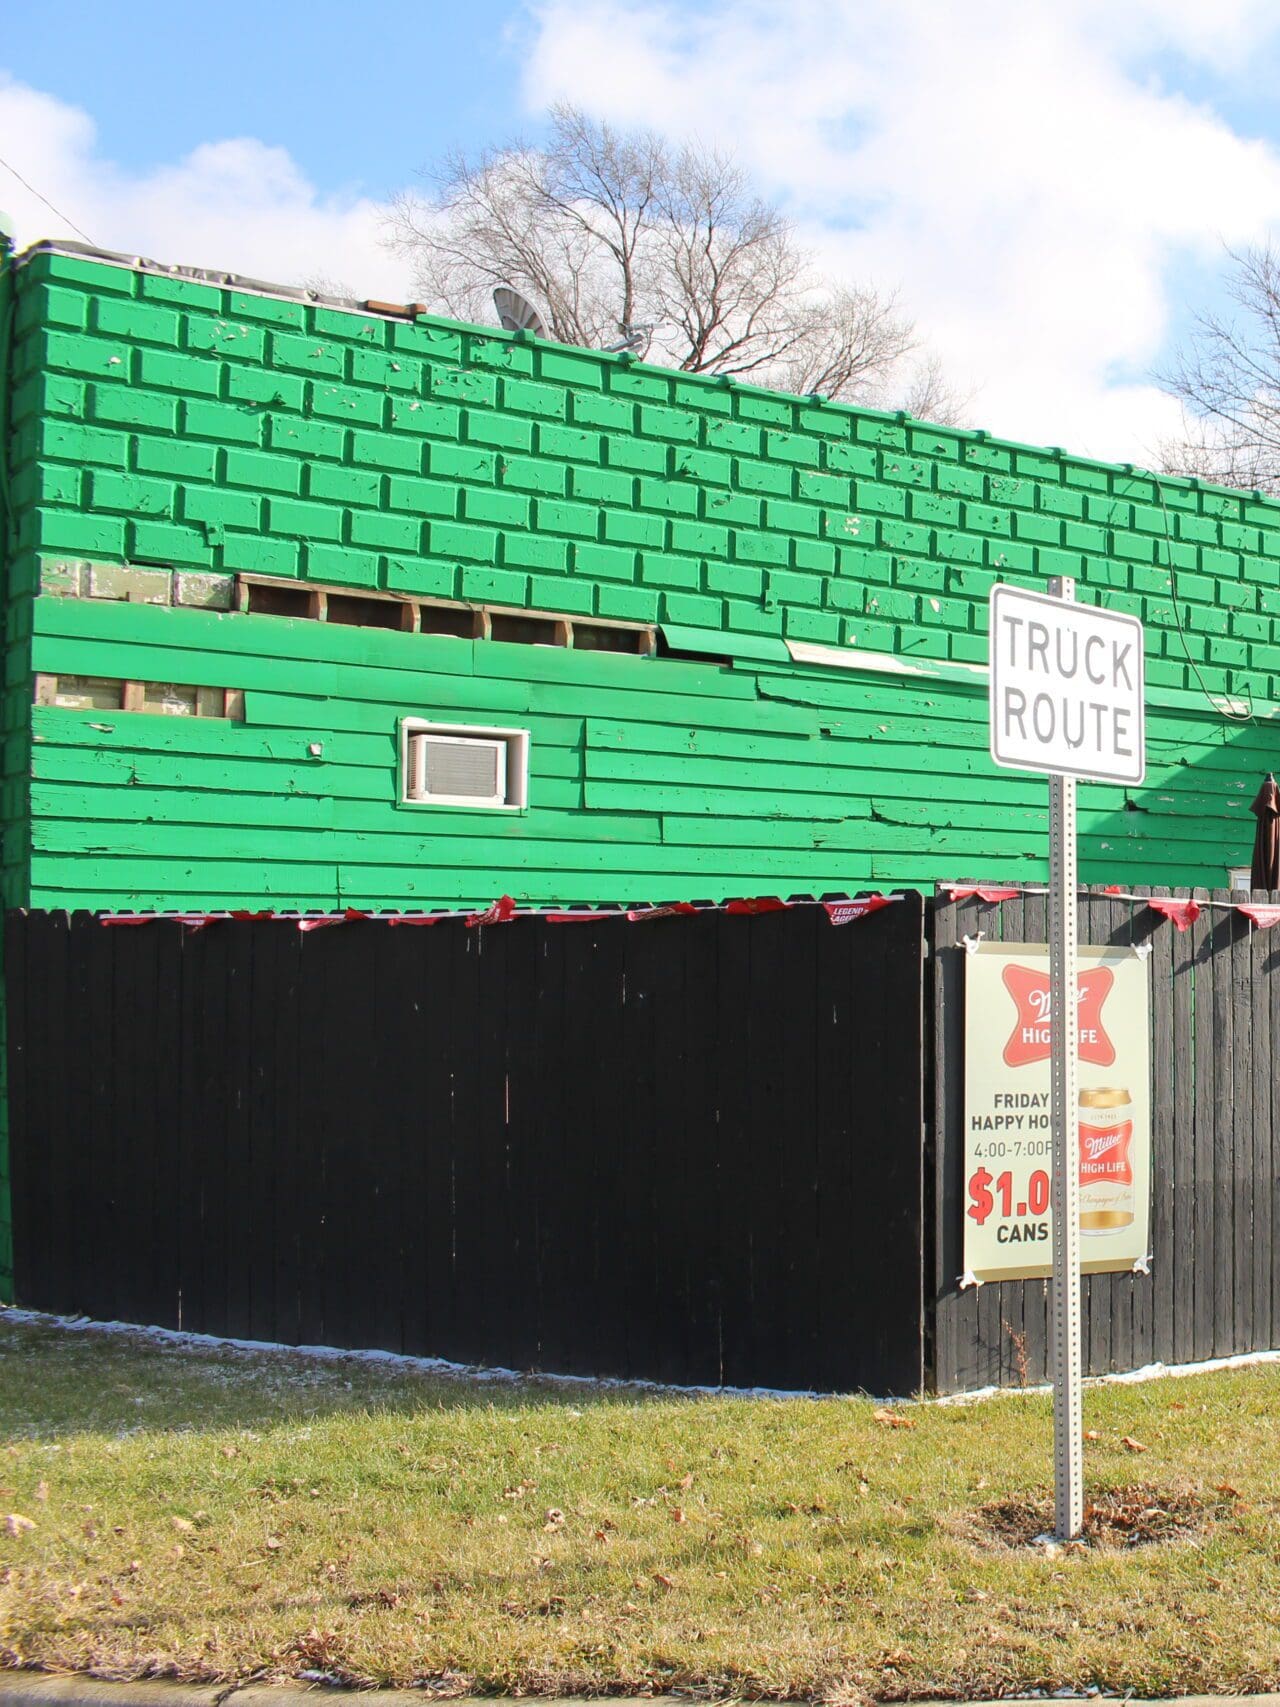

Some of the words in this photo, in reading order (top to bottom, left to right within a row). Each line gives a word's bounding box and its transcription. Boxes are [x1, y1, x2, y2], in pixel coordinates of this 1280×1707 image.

[1003, 615, 1132, 691] TRUCK
[1005, 686, 1132, 757] ROUTE
[1022, 1027, 1051, 1044] HIG
[994, 1093, 1049, 1108] FRIDAY
[972, 1115, 1024, 1131] HAPPY
[1028, 1114, 1052, 1129] HO
[974, 1140, 1053, 1158] 4:00-7:00P
[1085, 1134, 1124, 1159] Miller
[1080, 1163, 1104, 1174] HIGH
[1107, 1161, 1126, 1173] LIFE
[967, 1166, 1050, 1226] $1.0
[997, 1223, 1049, 1244] CANS
